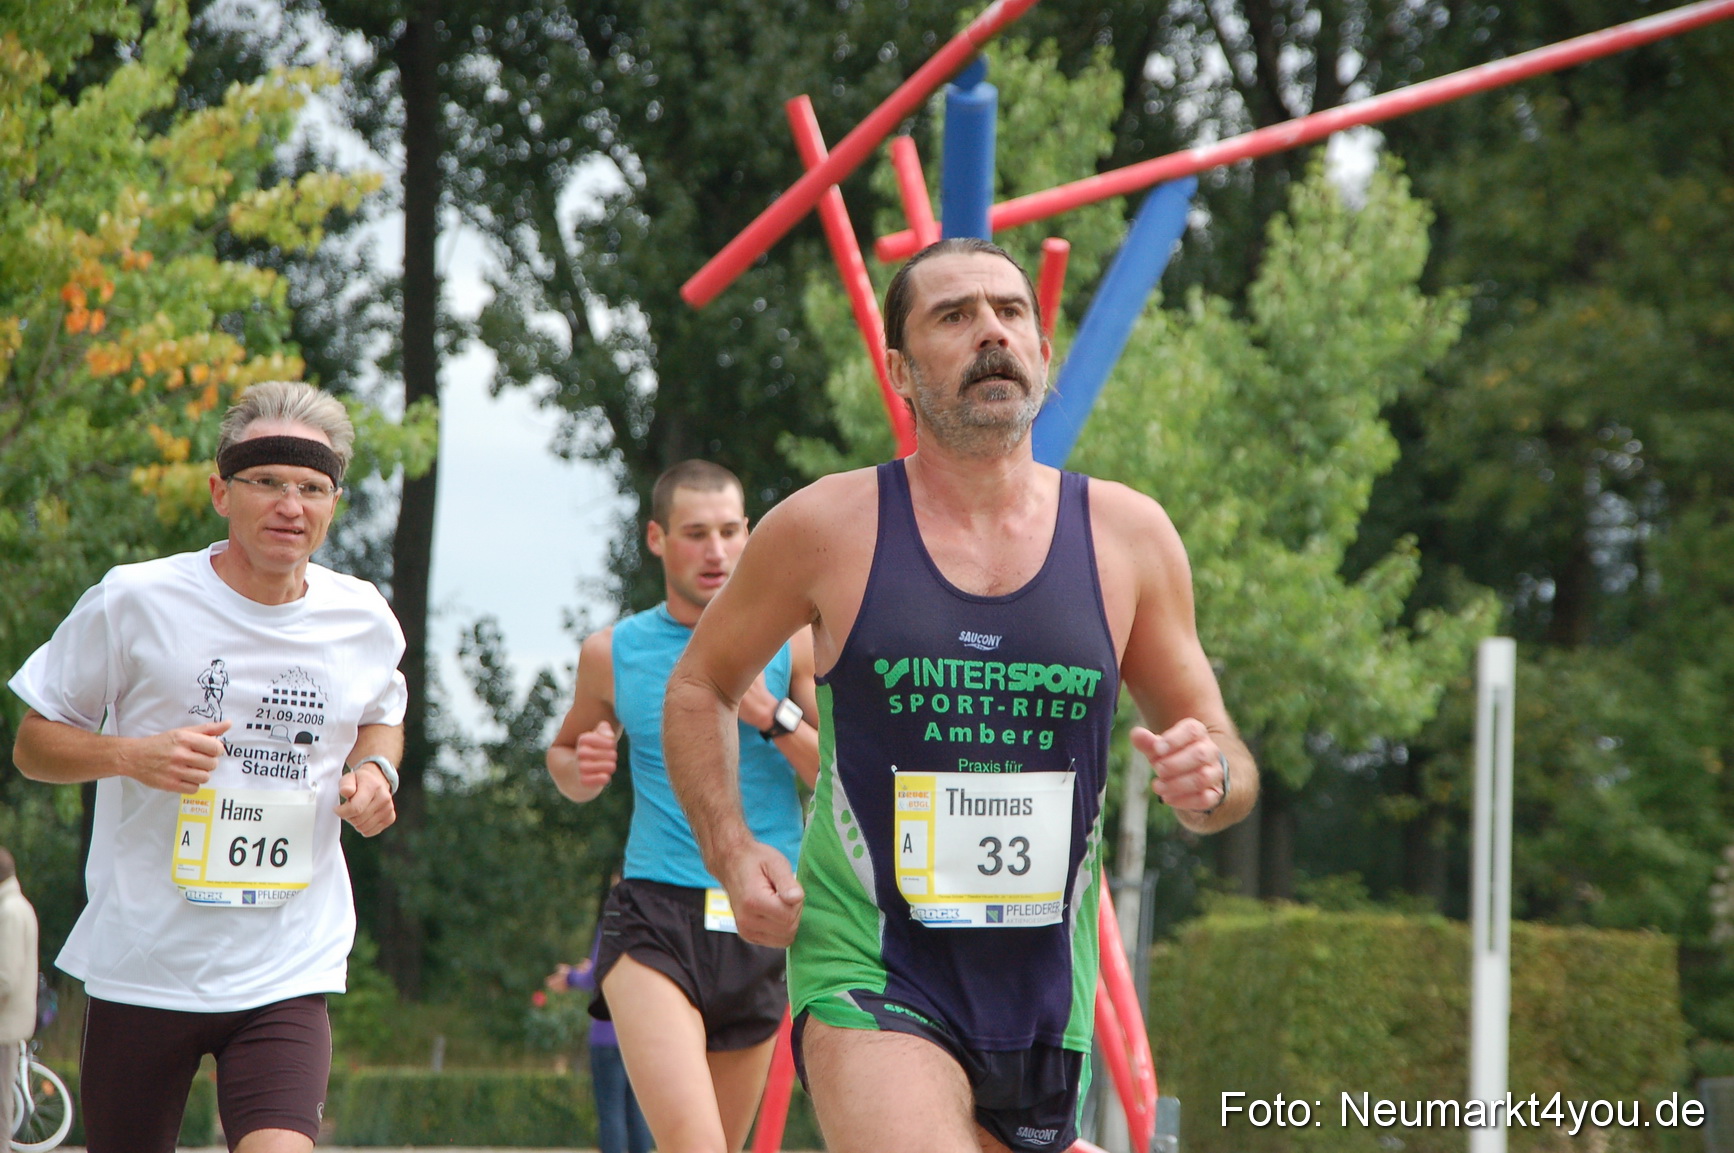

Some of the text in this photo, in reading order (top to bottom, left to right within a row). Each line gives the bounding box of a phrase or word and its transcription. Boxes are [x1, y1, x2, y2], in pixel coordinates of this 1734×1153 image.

[958, 630, 1003, 647] SAUCONY
[912, 657, 1103, 698] INTERSPORT
[255, 707, 325, 726] 21.09.2008
[889, 693, 1088, 721] SPORT-RIED
[924, 722, 1054, 750] Amberg
[241, 760, 308, 780] Stadtlaf
[958, 758, 1024, 773] Praxis für
[220, 798, 264, 822] Hans
[946, 787, 1033, 816] Thomas
[181, 830, 191, 847] A
[902, 833, 913, 854] A
[227, 836, 290, 868] 616
[976, 836, 1032, 876] 33
[1006, 900, 1061, 916] PFLEIDERER
[1016, 1127, 1059, 1142] SAUCONY
